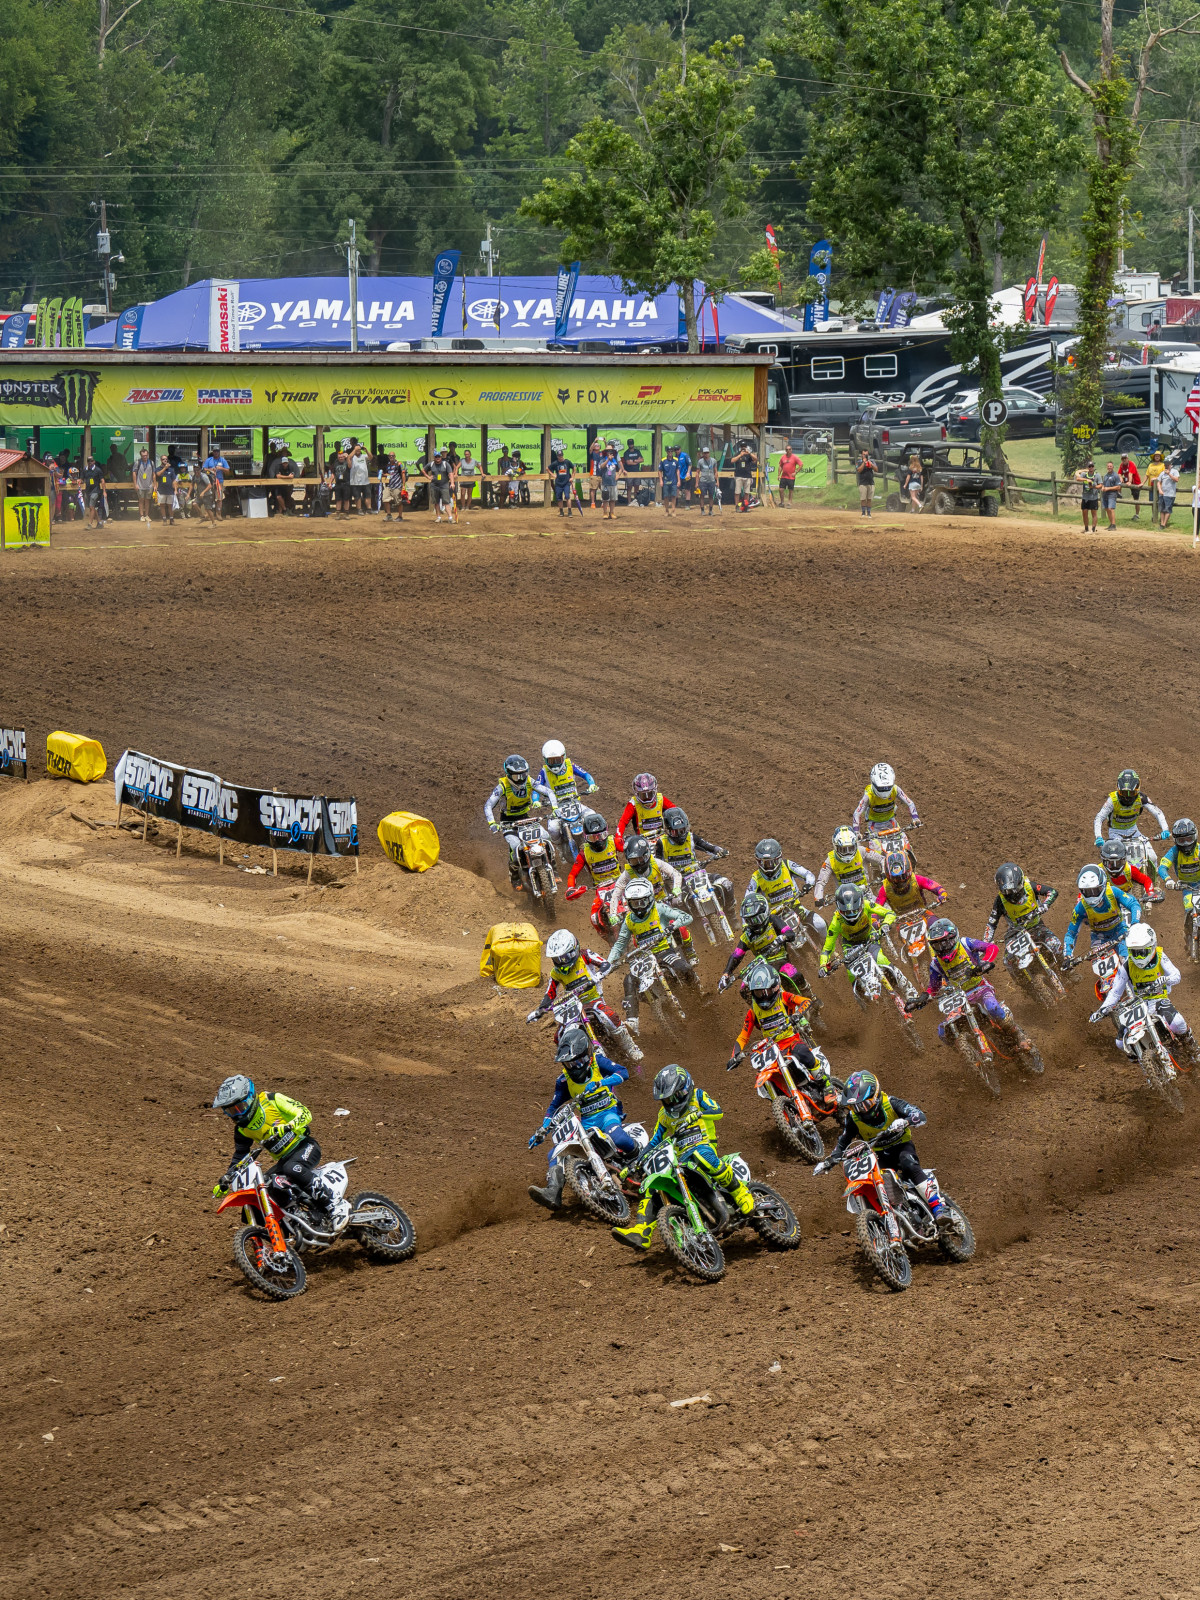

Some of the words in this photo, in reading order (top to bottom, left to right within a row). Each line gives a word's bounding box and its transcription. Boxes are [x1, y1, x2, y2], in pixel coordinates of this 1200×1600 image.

[217, 287, 229, 352] awasaki
[270, 298, 415, 322] YAMAHA
[431, 293, 446, 332] YAMAHA
[512, 298, 659, 321] YAMAHA
[0, 381, 60, 396] ONSTER
[127, 389, 185, 403] AMSOIL
[197, 388, 253, 399] PARTS
[281, 391, 320, 403] THOR
[477, 391, 545, 402] PROGRESSIVE
[576, 389, 610, 404] FOX
[689, 394, 742, 402] LEGENDS
[1072, 427, 1096, 435] DIRTY
[46, 749, 72, 777] THOR
[124, 754, 174, 800] STACYC
[182, 774, 239, 822] STAYC
[562, 803, 580, 818] 53
[522, 828, 541, 840] 60
[1127, 845, 1141, 858] 41
[1009, 930, 1031, 951] 59
[853, 955, 873, 979] 37
[1097, 957, 1117, 977] 84
[559, 1004, 580, 1025] 78
[943, 996, 964, 1012] 55
[1123, 1004, 1146, 1026] 20
[751, 1046, 778, 1069] 34
[554, 1119, 575, 1143] 44
[646, 1149, 670, 1174] 16
[848, 1156, 872, 1181] 39
